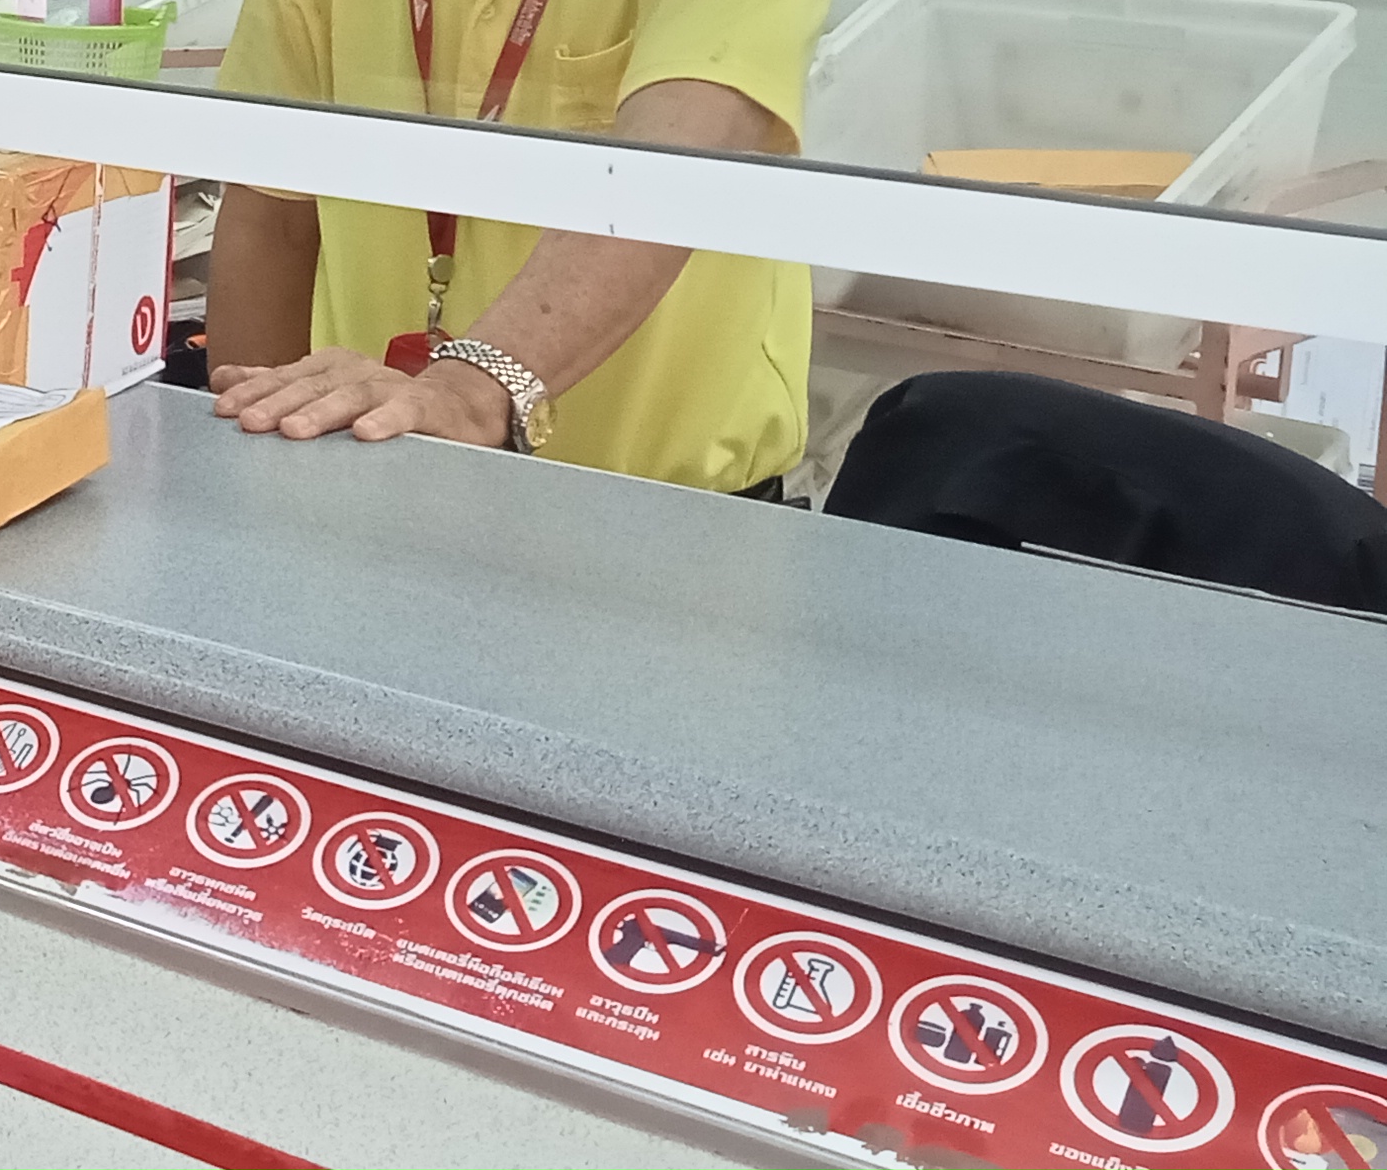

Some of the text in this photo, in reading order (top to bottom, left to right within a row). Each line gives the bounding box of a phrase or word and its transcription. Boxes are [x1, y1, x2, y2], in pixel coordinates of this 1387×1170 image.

[574, 1006, 661, 1042] และกระสุน
[589, 994, 661, 1025] อาวุธปืน
[702, 1047, 737, 1068] เช่น
[743, 1043, 807, 1072] สารพิษ
[895, 1090, 997, 1135] เชื้อชีวภาพ
